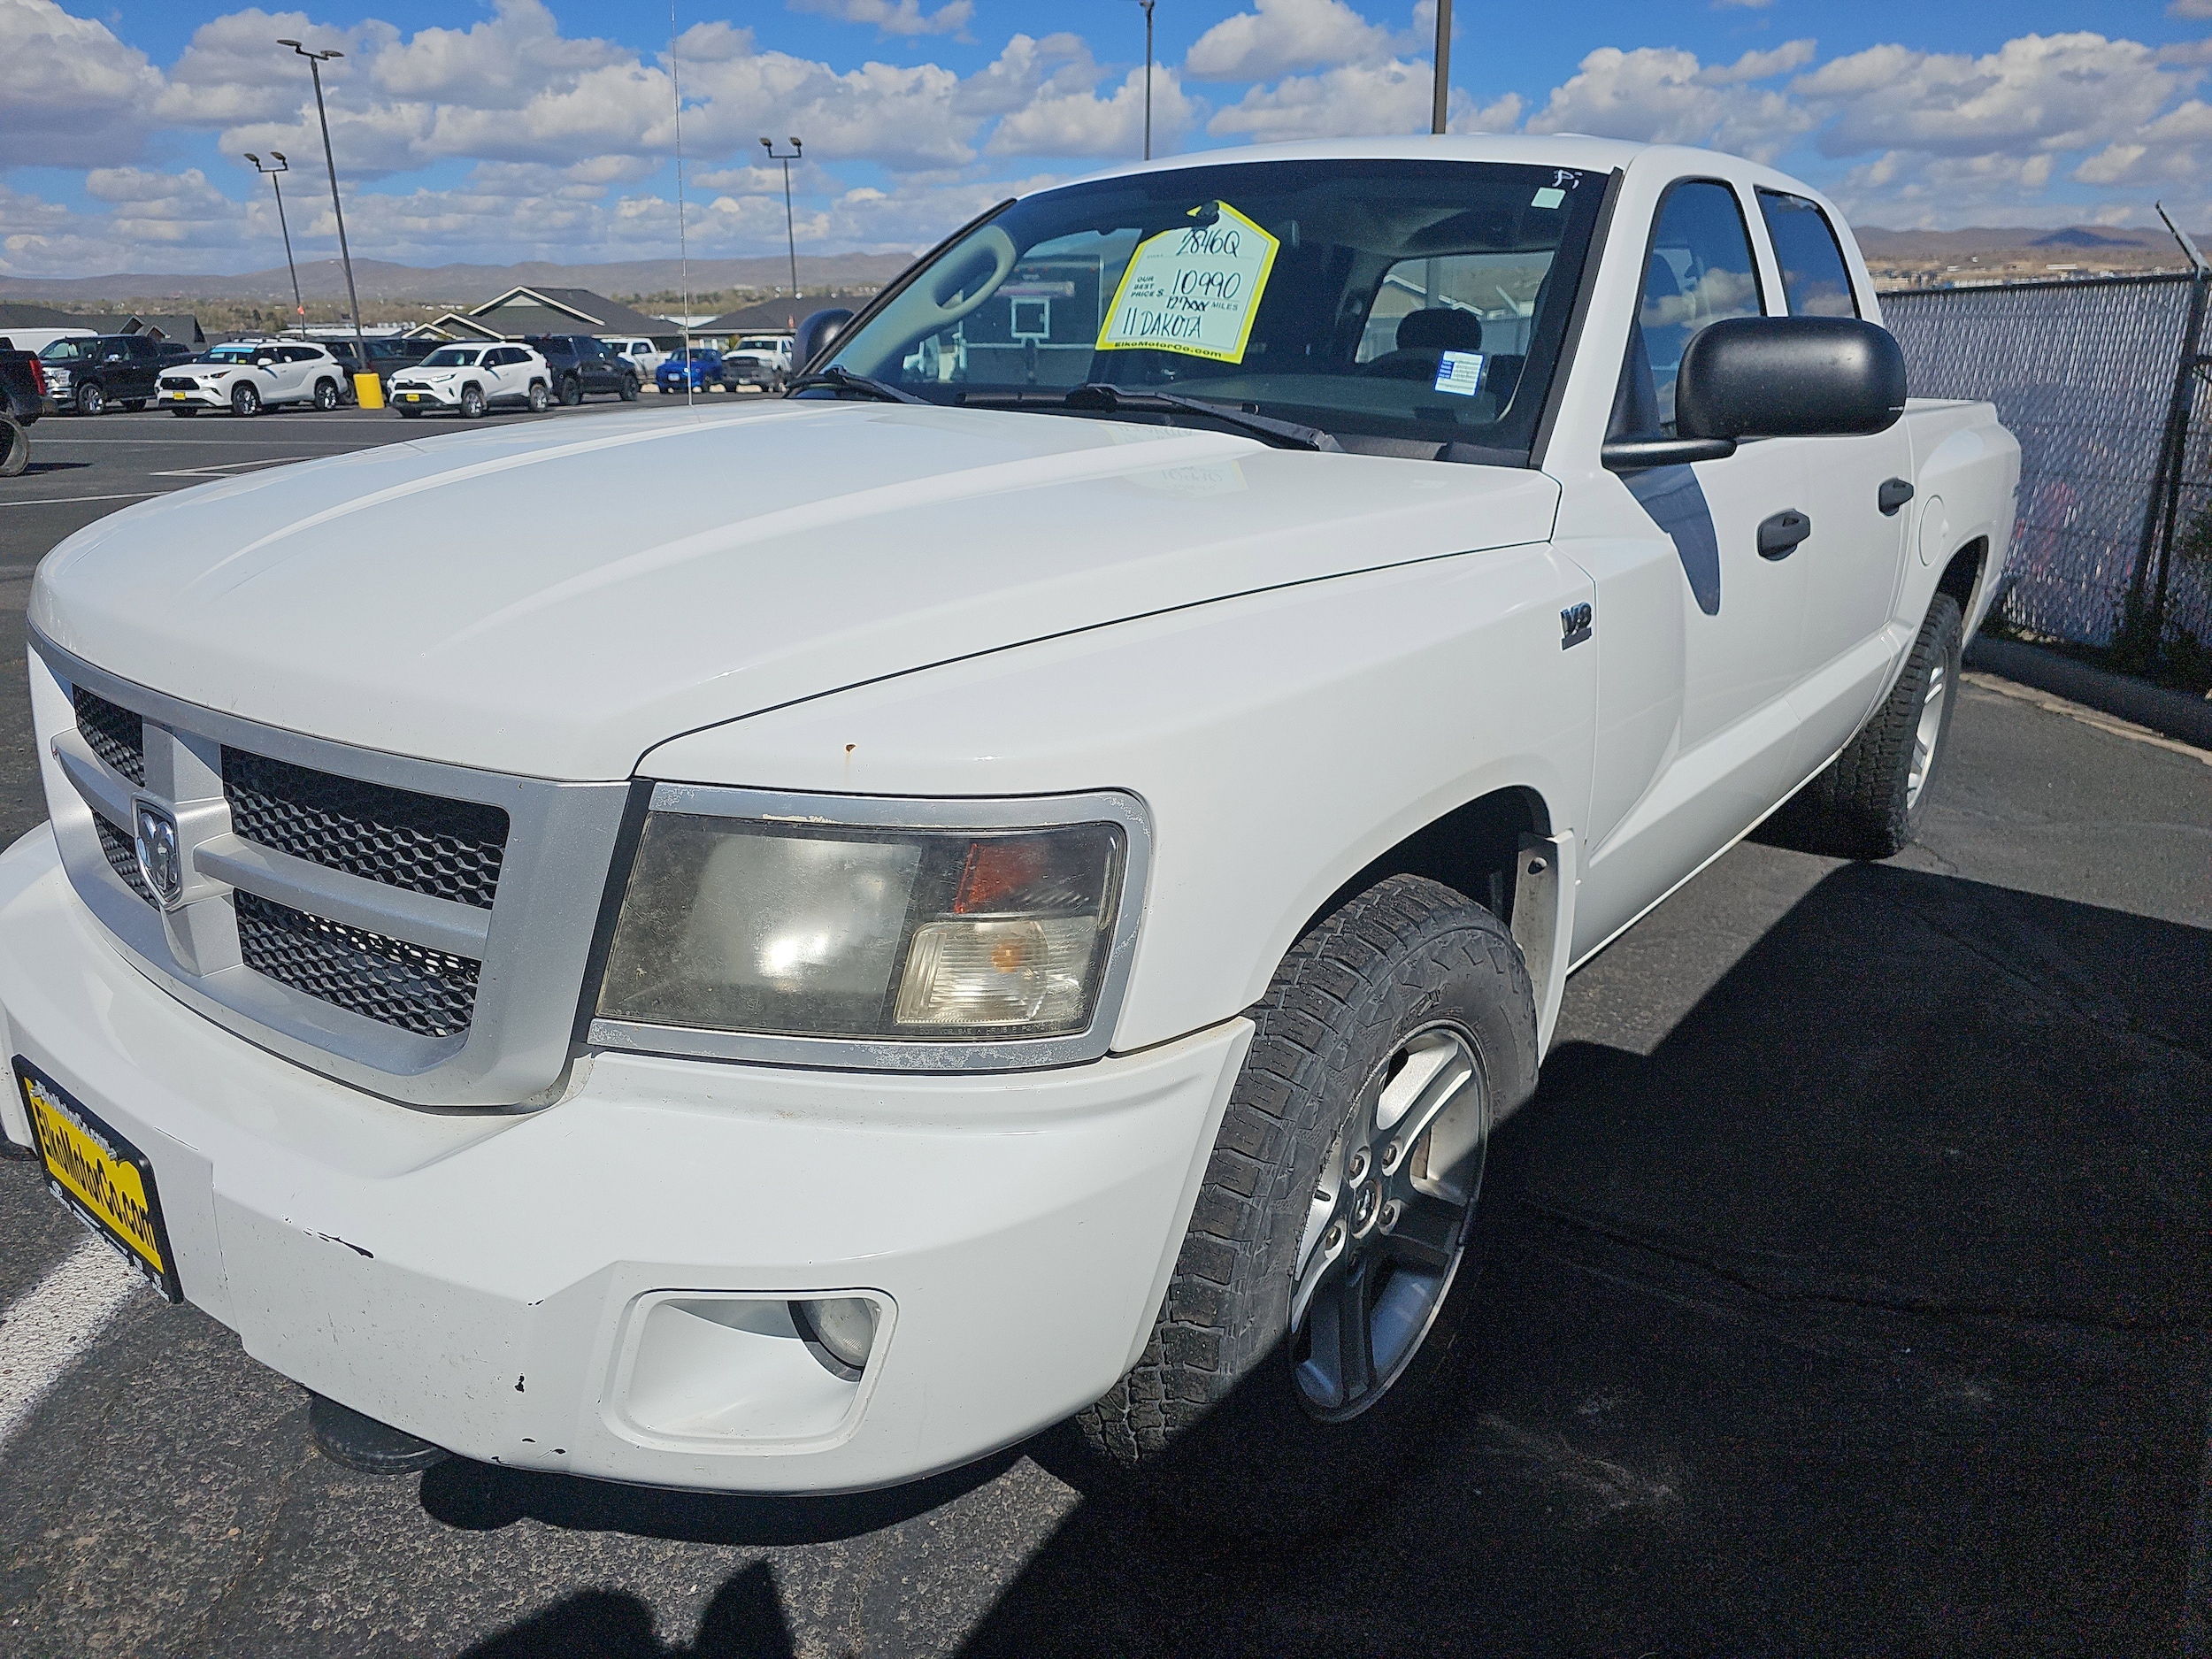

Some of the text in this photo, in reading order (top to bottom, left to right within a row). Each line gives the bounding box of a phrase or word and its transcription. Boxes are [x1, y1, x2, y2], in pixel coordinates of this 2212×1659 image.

[1156, 288, 1164, 297] $
[1171, 269, 1240, 299] 10990
[1211, 301, 1239, 311] MILES
[1141, 311, 1201, 338] DAKOTA
[1115, 342, 1222, 357] ElkoMotorCo.com
[34, 1102, 157, 1252] ElkoMotorCo.com
